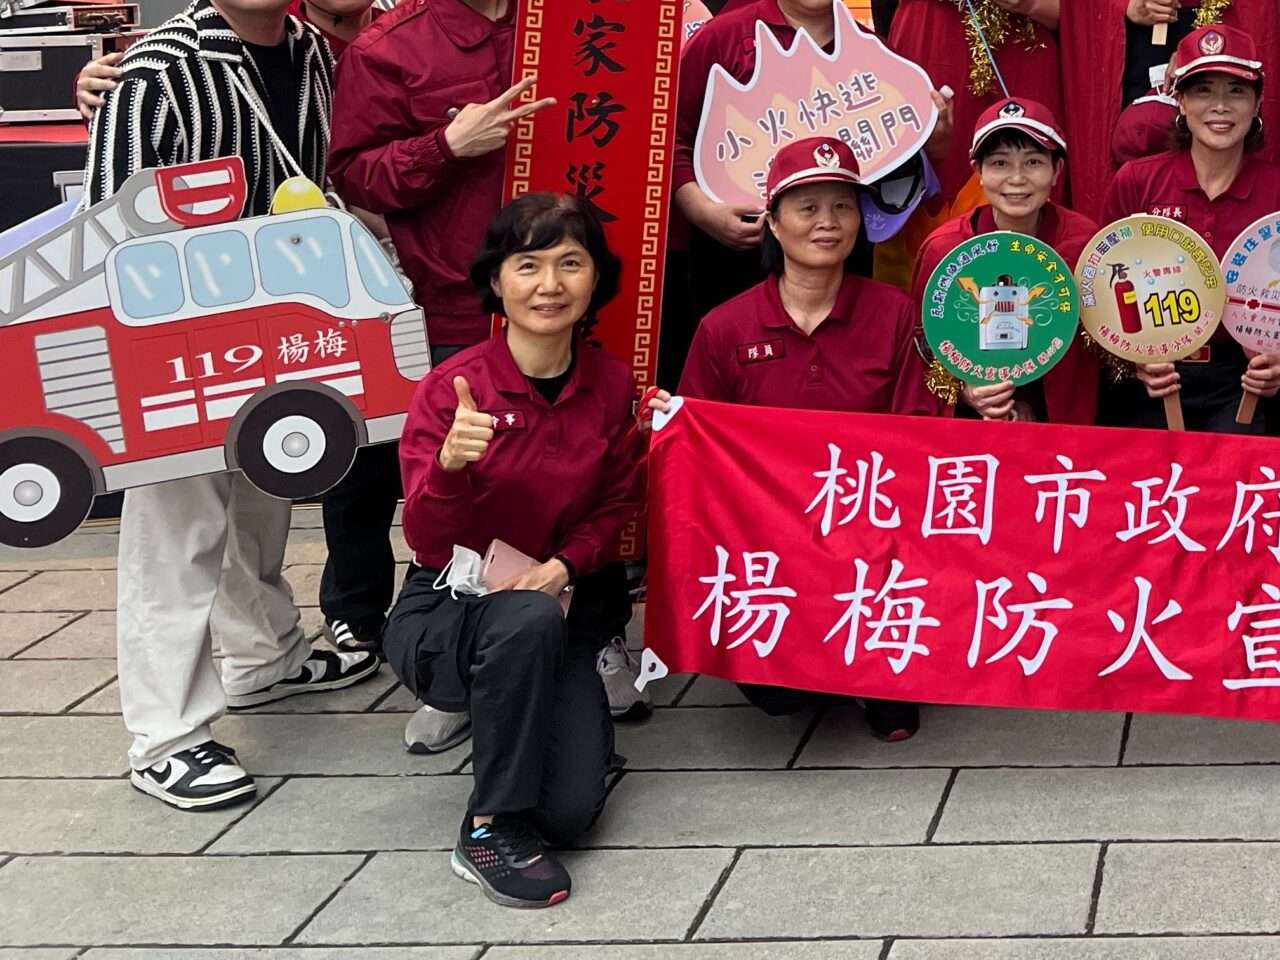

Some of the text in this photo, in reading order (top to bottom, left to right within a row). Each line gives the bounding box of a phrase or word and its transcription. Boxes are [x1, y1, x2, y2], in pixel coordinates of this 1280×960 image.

[717, 73, 882, 160] 小火快逃
[1144, 288, 1201, 327] 119
[165, 327, 349, 385] 119 楊梅
[748, 345, 774, 359] 隊員
